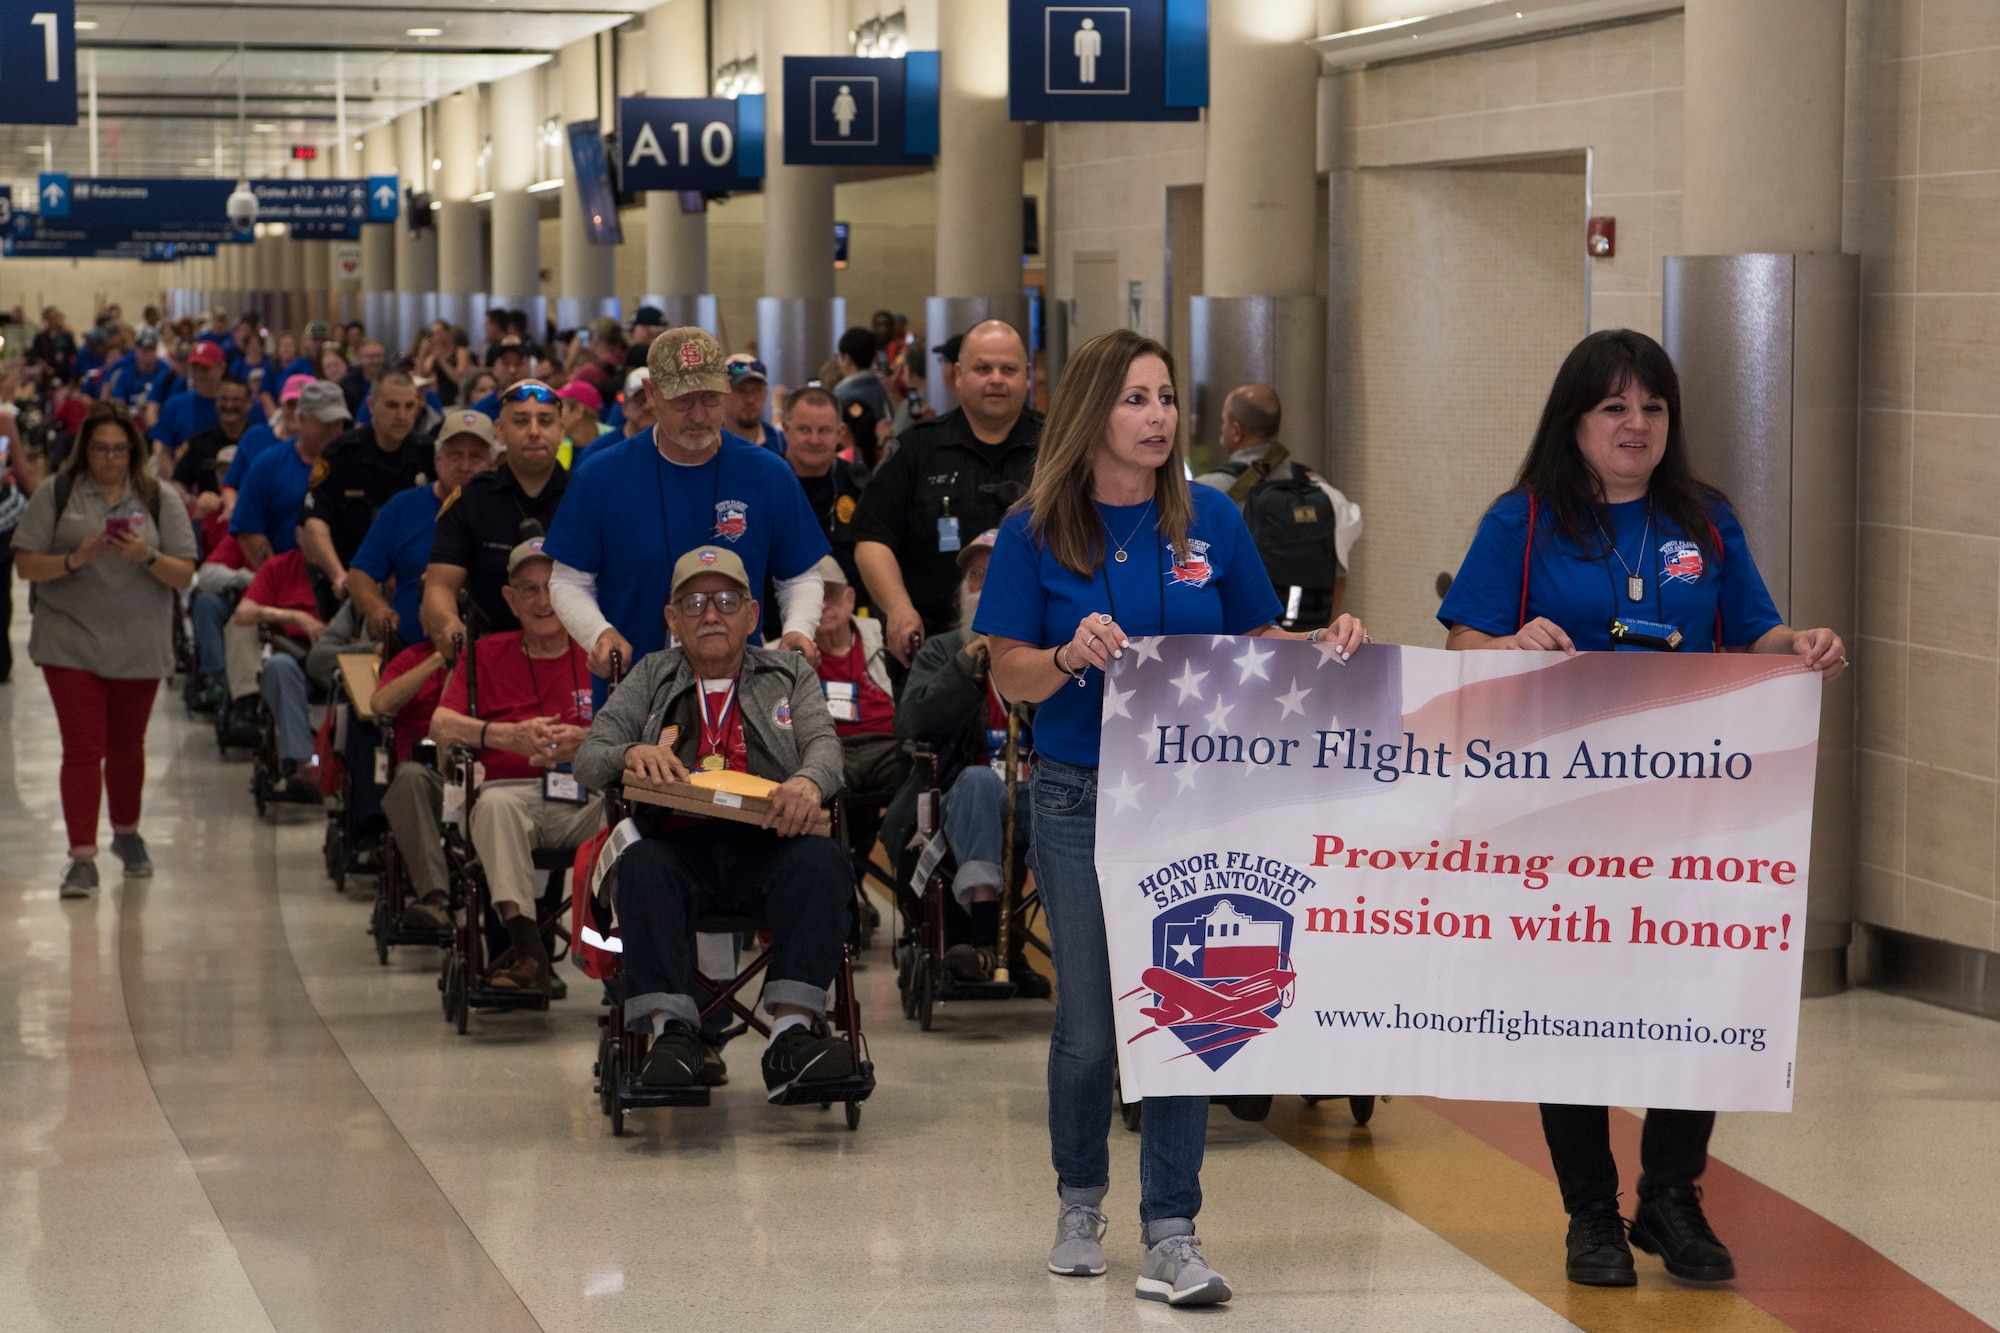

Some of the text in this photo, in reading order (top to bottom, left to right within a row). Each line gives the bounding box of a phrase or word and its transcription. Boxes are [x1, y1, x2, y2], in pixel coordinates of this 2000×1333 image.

[627, 121, 733, 167] A10
[1155, 724, 1752, 782] Honor Flight San Antonio
[1138, 851, 1317, 898] HONOR FLIGHT
[1309, 834, 1797, 890] Providing one more
[1154, 871, 1297, 910] SAN ANTONIO
[1305, 896, 1792, 952] mission with honor!
[1315, 1003, 1767, 1052] www.honorflightsanantonio.org
